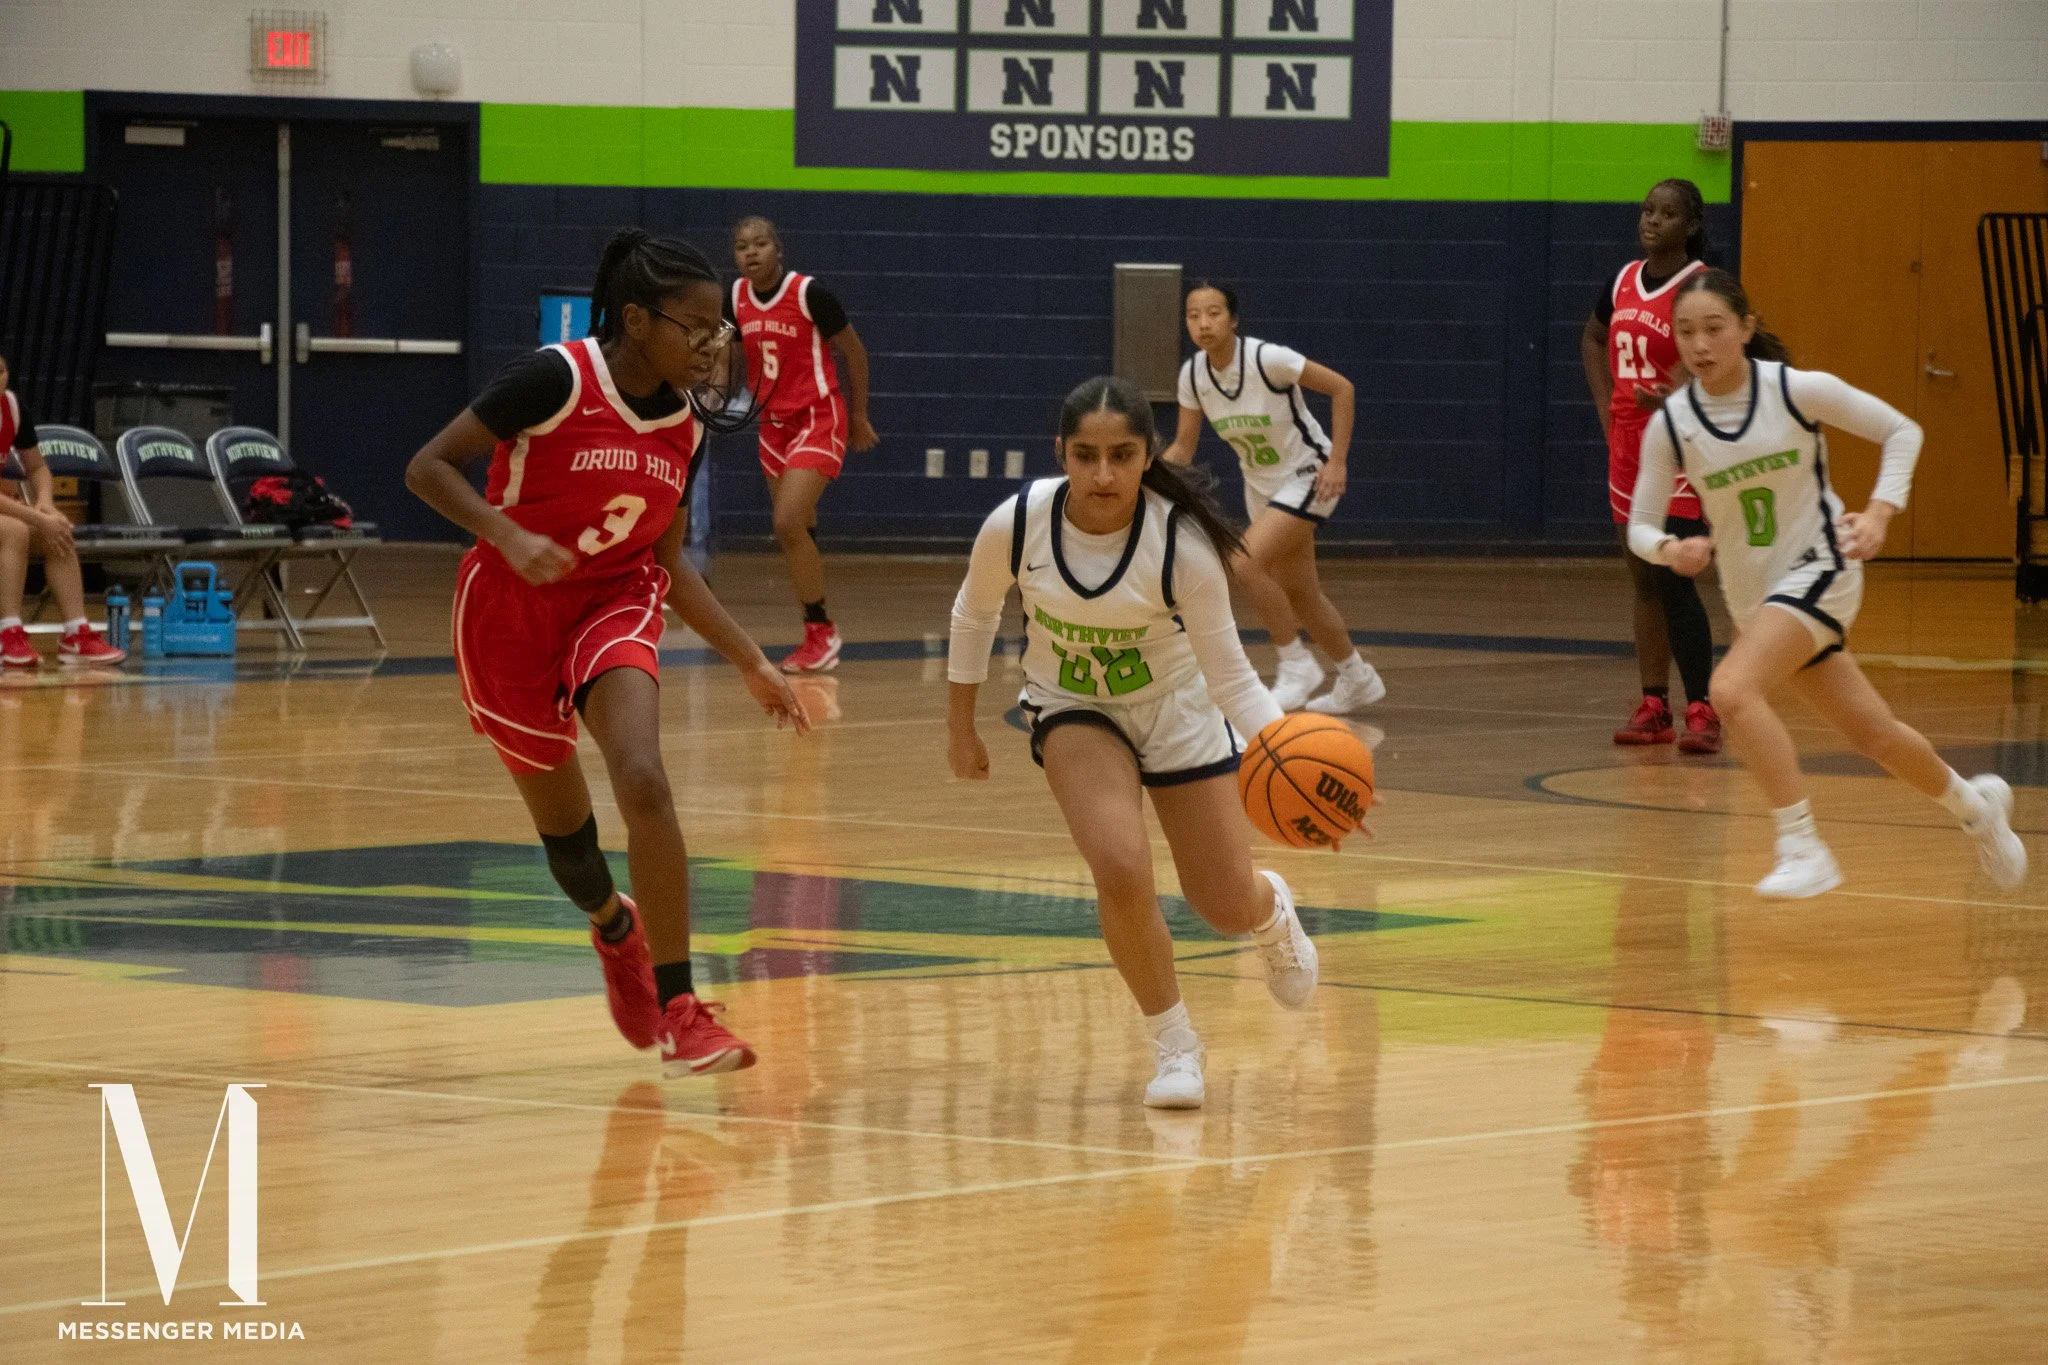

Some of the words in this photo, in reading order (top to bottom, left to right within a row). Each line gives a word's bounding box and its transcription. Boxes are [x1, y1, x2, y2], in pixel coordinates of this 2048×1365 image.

[267, 31, 310, 67] EXIT
[870, 55, 921, 103] N
[1002, 57, 1053, 105] N
[1134, 60, 1185, 108] N
[1266, 63, 1317, 110] N
[990, 123, 1195, 161] SPONSORS
[764, 320, 798, 338] HILLS
[1637, 310, 1671, 338] HILLS
[757, 340, 779, 380] 5
[1615, 330, 1657, 379] 21
[37, 439, 98, 462] ORTHVIEW
[137, 441, 195, 463] NORTHVIEW
[226, 441, 281, 464] NORTHVIEW
[570, 448, 638, 472] DRUID
[644, 454, 686, 497] HILL
[577, 494, 647, 556] 3
[1738, 486, 1776, 547] 0
